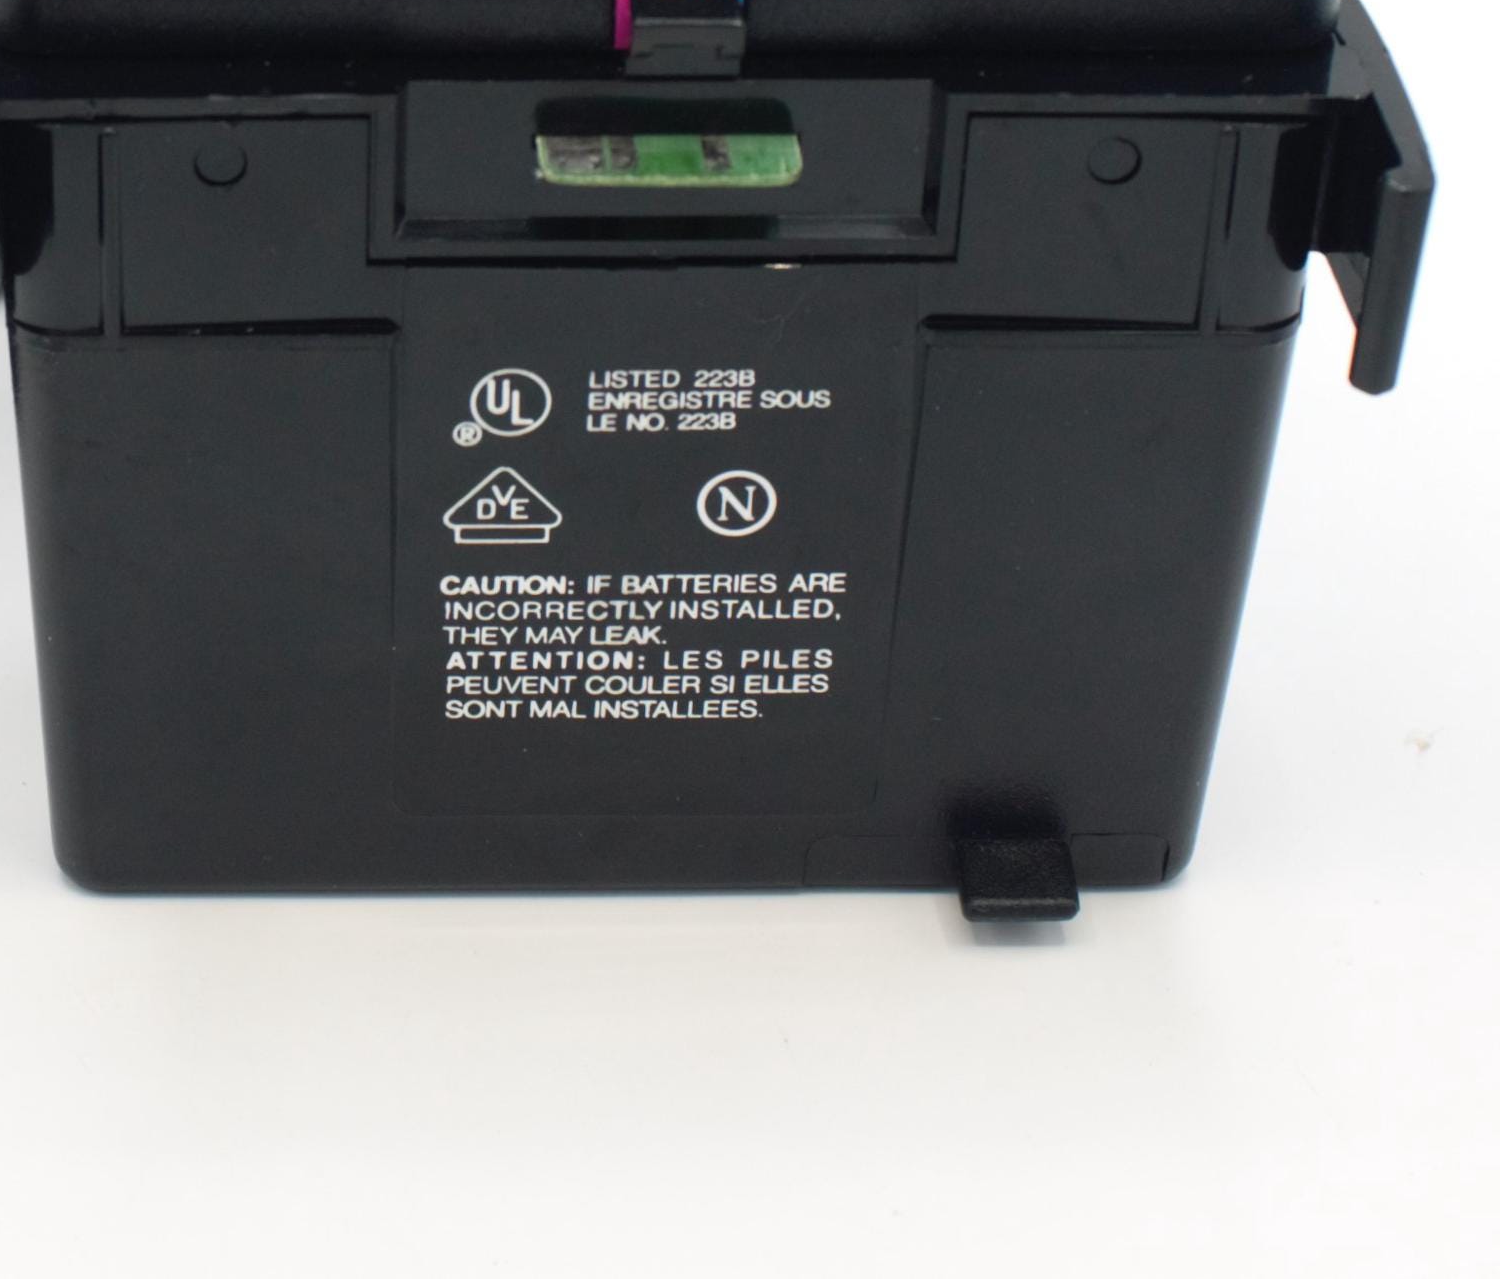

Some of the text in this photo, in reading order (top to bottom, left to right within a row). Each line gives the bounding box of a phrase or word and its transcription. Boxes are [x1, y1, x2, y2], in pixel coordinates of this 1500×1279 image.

[588, 369, 756, 389] LISTED 223B
[485, 377, 536, 426] UL
[587, 389, 832, 410] ENREGISTRE SOUS
[585, 412, 737, 432] LE NO. 223B
[716, 485, 756, 522] N
[439, 572, 847, 597] CAUTION: IF BATTERIES ARE
[444, 598, 842, 623] INCORRECTLY INSTALLED,
[442, 625, 668, 646] THEY MAY LEAK.
[445, 649, 833, 671] ATTENTION: LES PILES
[446, 673, 829, 695] PEUVENT COULER SI ELLES
[444, 699, 764, 720] SONT MAL INSTALLEES.
